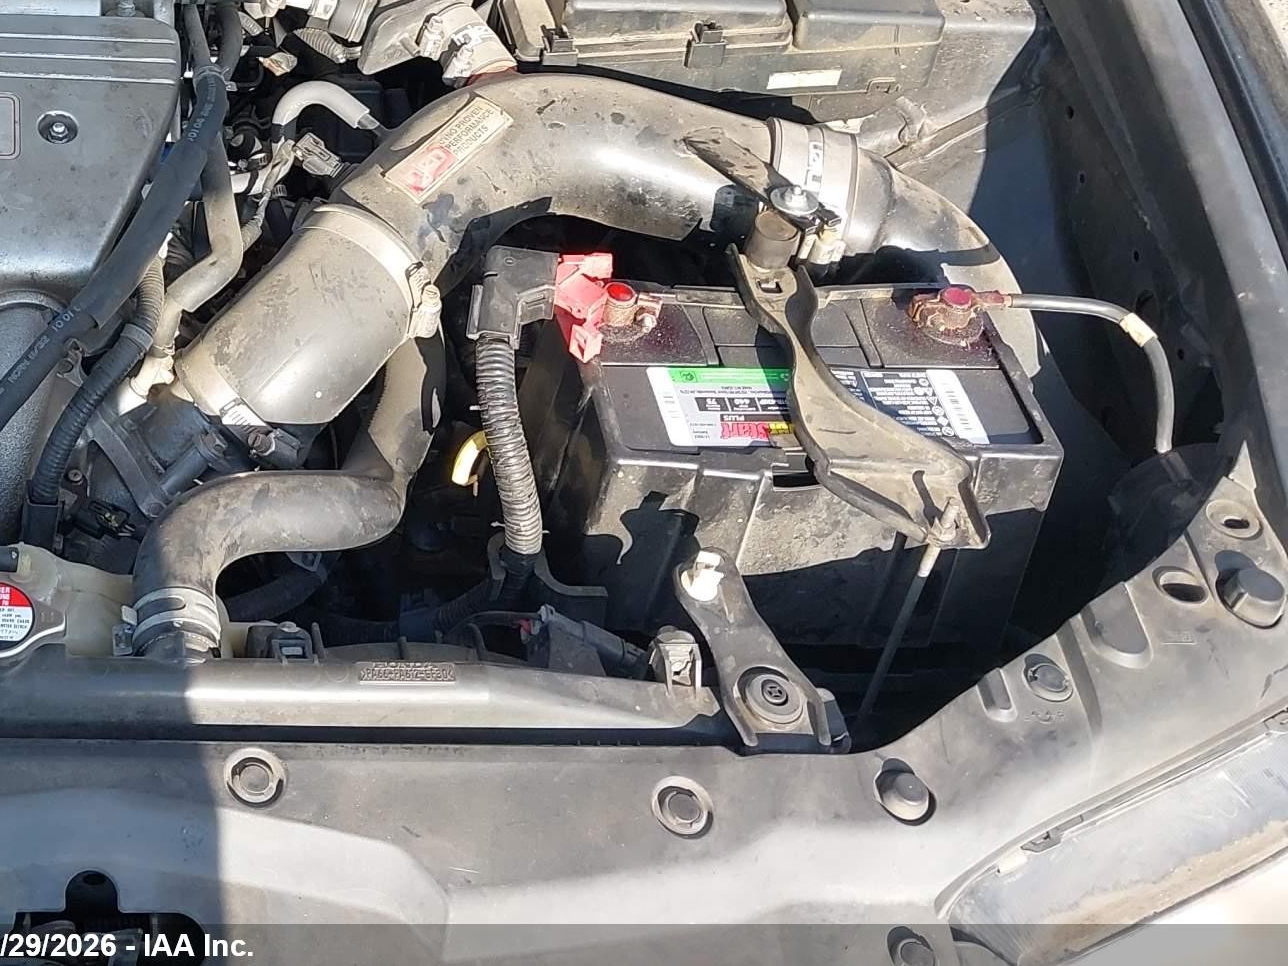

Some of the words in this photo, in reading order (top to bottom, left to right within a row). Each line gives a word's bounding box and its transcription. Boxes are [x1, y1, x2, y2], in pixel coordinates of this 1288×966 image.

[445, 108, 494, 150] PERFORMANCE
[456, 106, 484, 131] PROVEN
[453, 124, 490, 156] PRODUCTS
[723, 414, 745, 422] PLUS
